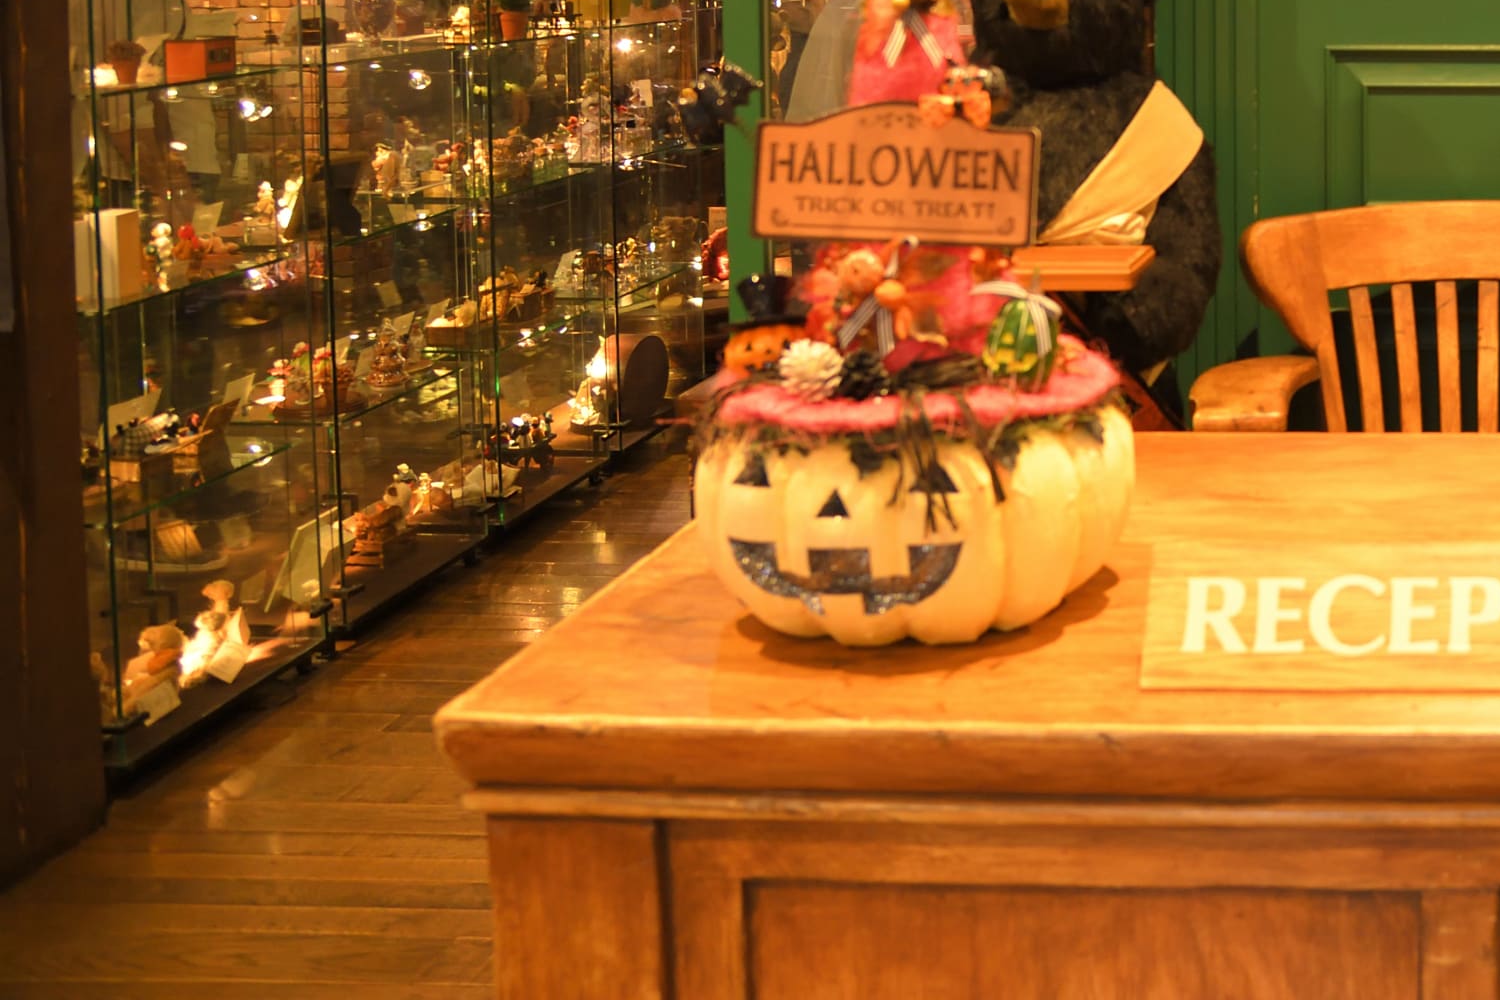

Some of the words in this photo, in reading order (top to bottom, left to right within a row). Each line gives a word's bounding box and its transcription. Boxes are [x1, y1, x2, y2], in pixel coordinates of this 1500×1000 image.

[769, 142, 1019, 190] HALLOWEEN
[794, 195, 863, 215] TRICK
[871, 198, 905, 217] OR
